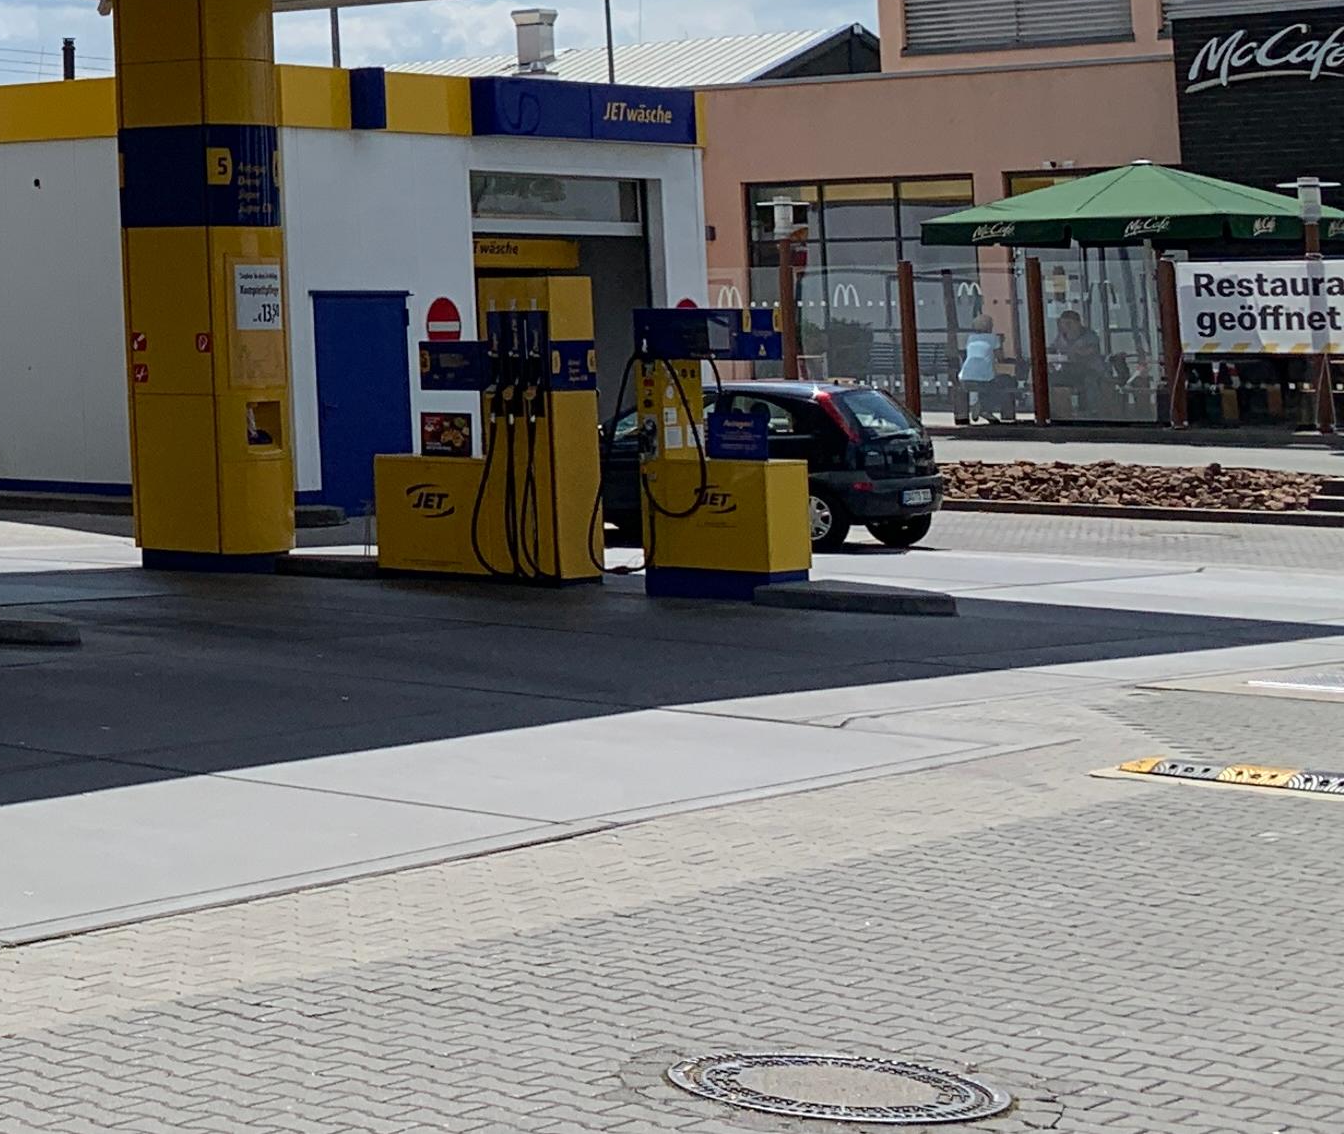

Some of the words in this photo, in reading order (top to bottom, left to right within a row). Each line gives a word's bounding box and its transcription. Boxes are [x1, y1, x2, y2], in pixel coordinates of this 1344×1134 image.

[218, 157, 227, 175] 5
[1196, 305, 1342, 337] geöffnet
[413, 492, 449, 509] JET
